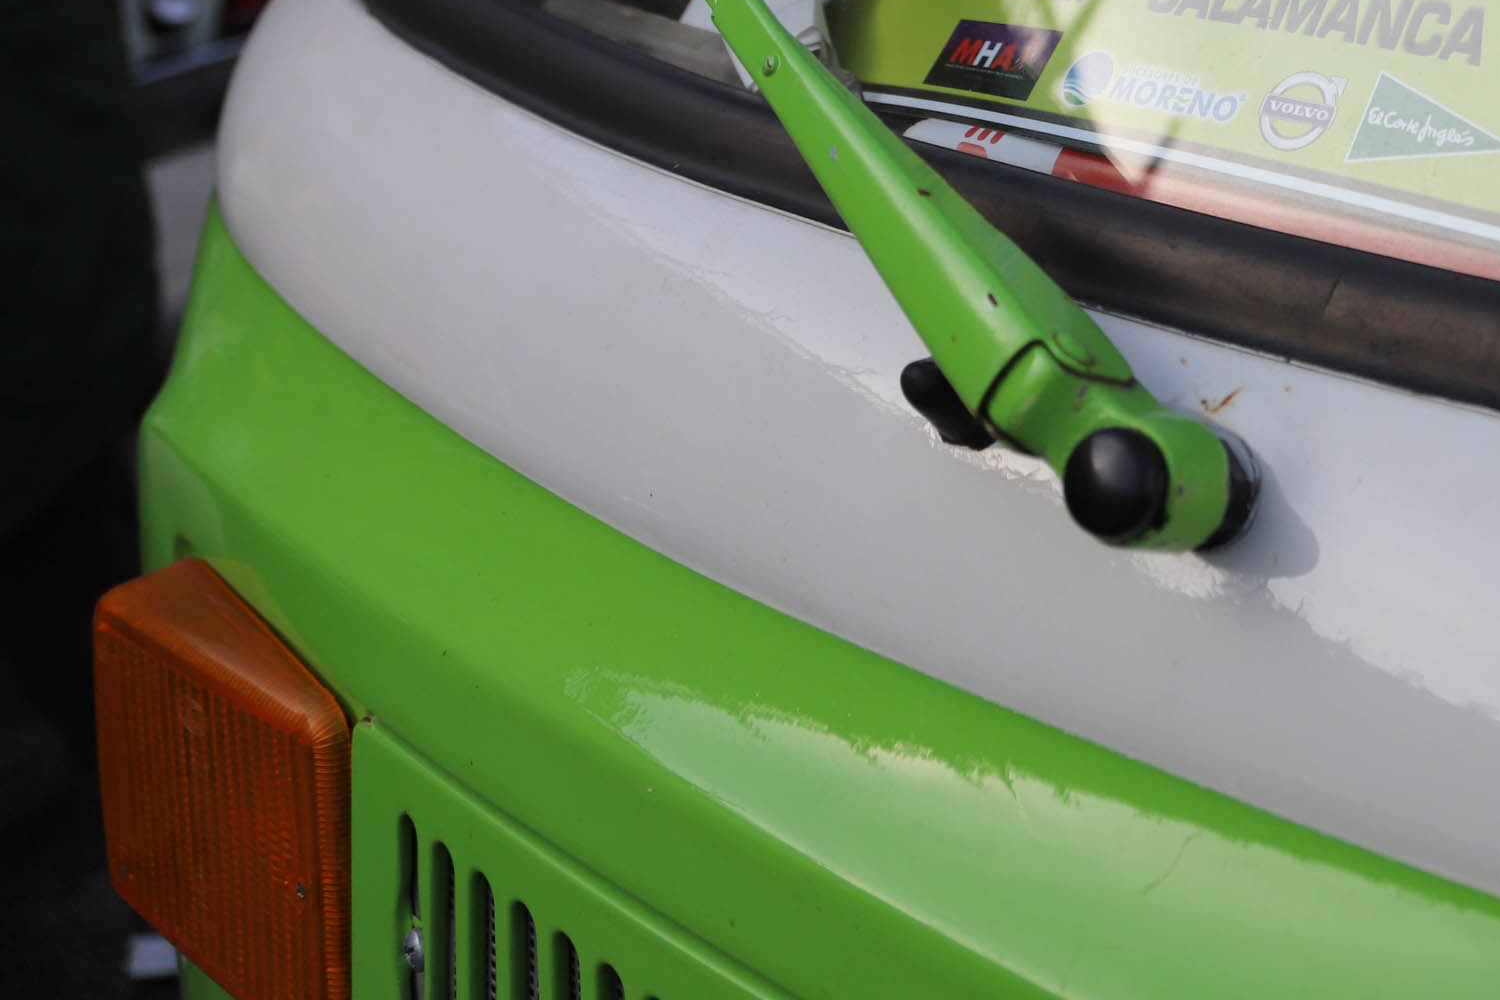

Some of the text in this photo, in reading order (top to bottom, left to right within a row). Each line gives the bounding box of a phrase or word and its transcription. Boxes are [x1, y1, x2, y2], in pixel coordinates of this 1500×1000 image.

[1109, 74, 1239, 122] MORENO
[1268, 99, 1331, 122] VOLVO
[1367, 106, 1383, 125] El
[1383, 111, 1419, 134] Corte
